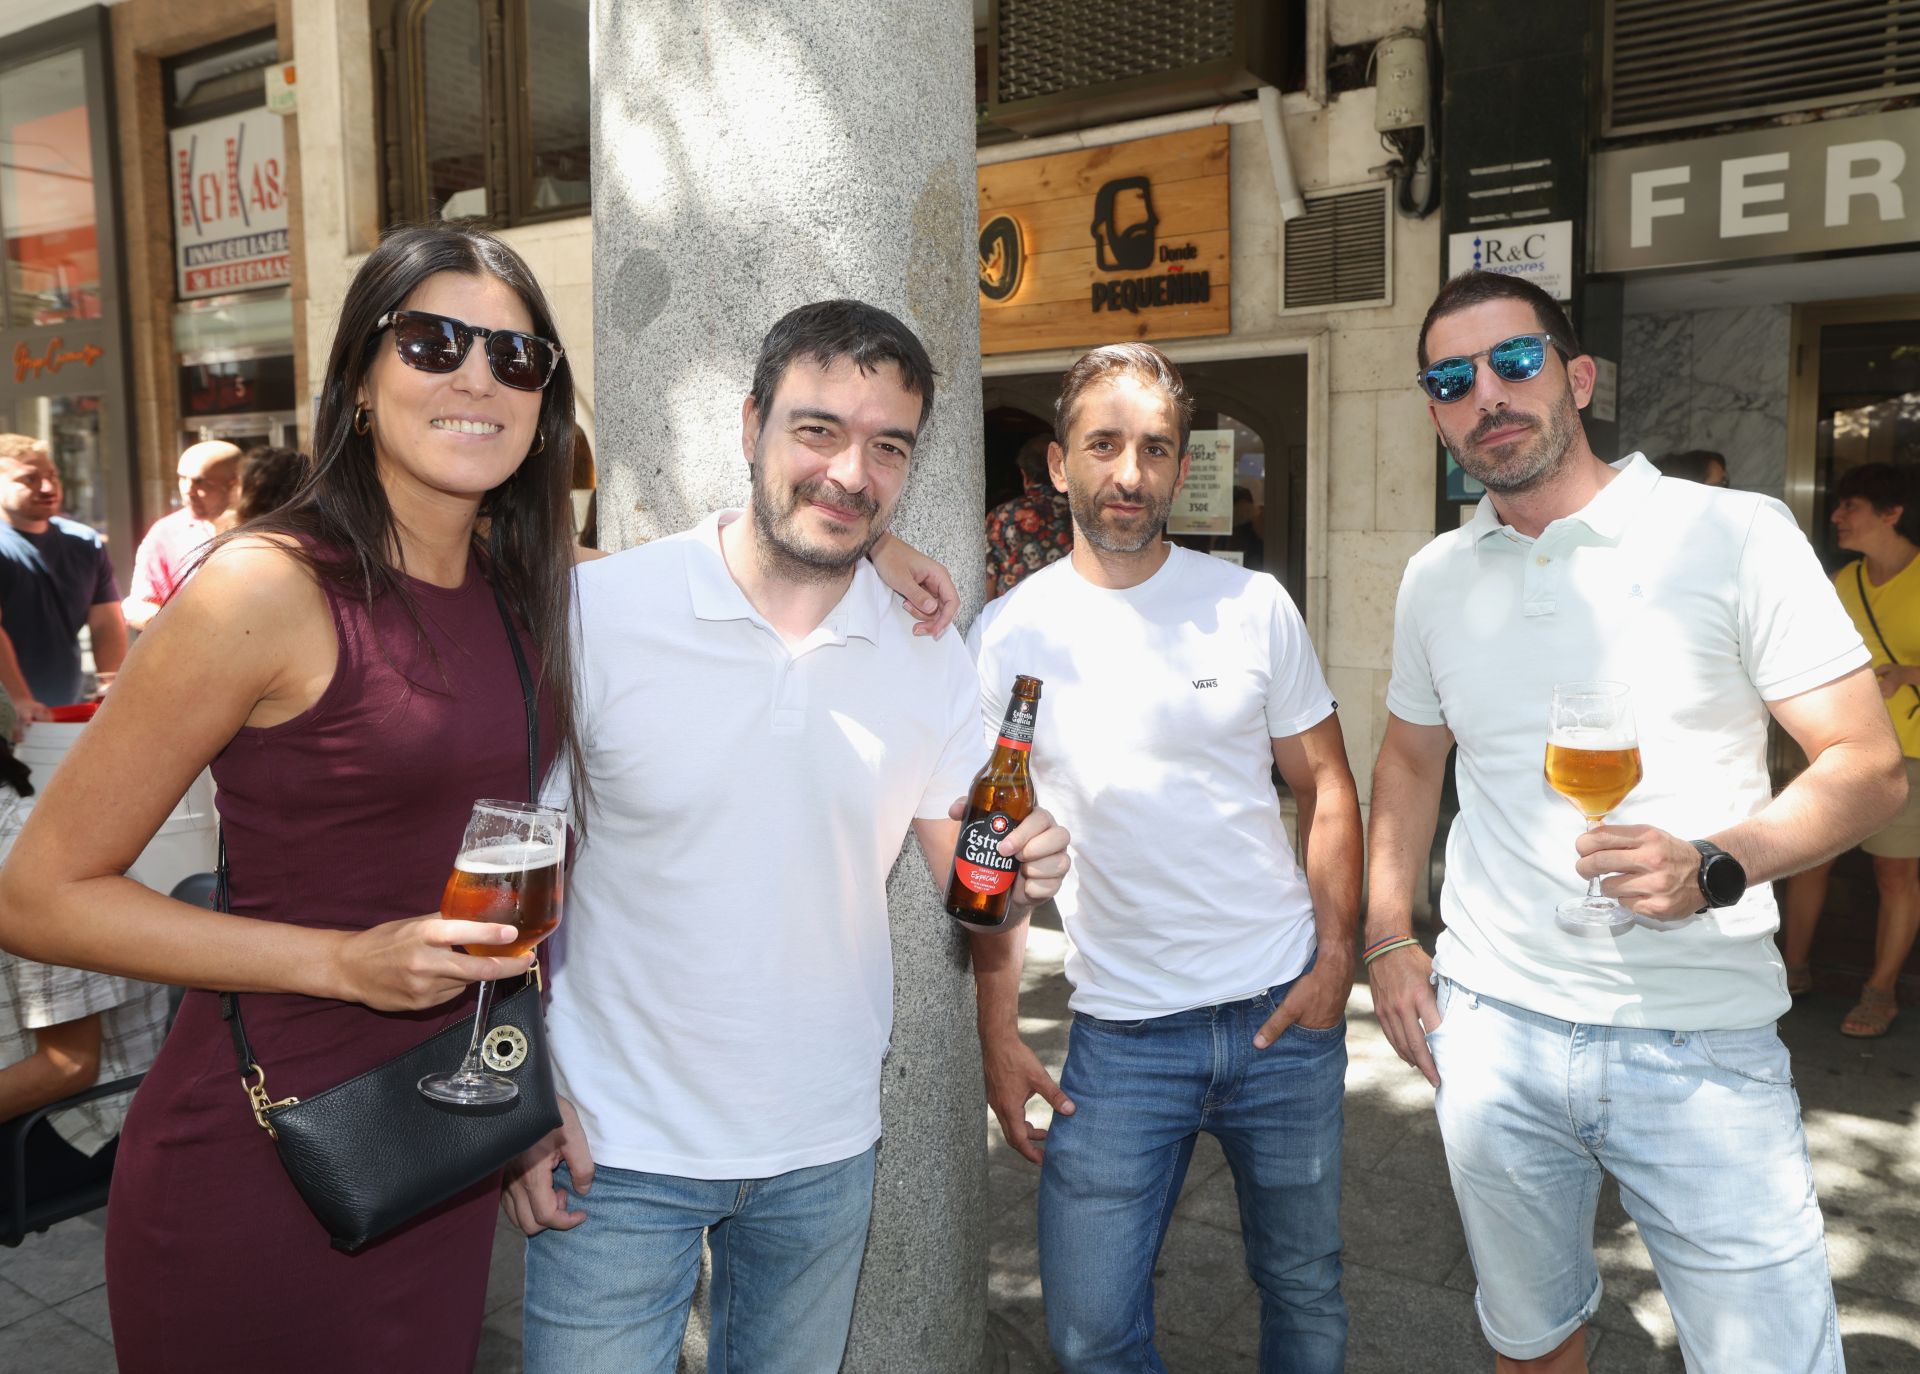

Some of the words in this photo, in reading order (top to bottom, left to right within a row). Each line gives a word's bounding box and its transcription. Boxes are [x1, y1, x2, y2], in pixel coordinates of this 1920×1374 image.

[1630, 139, 1906, 248] FER
[188, 231, 288, 265] INMOBILIARI
[1159, 243, 1198, 262] Donde
[1192, 678, 1218, 689] VANS
[965, 844, 1013, 870] Galicia
[970, 870, 1000, 885] Especial
